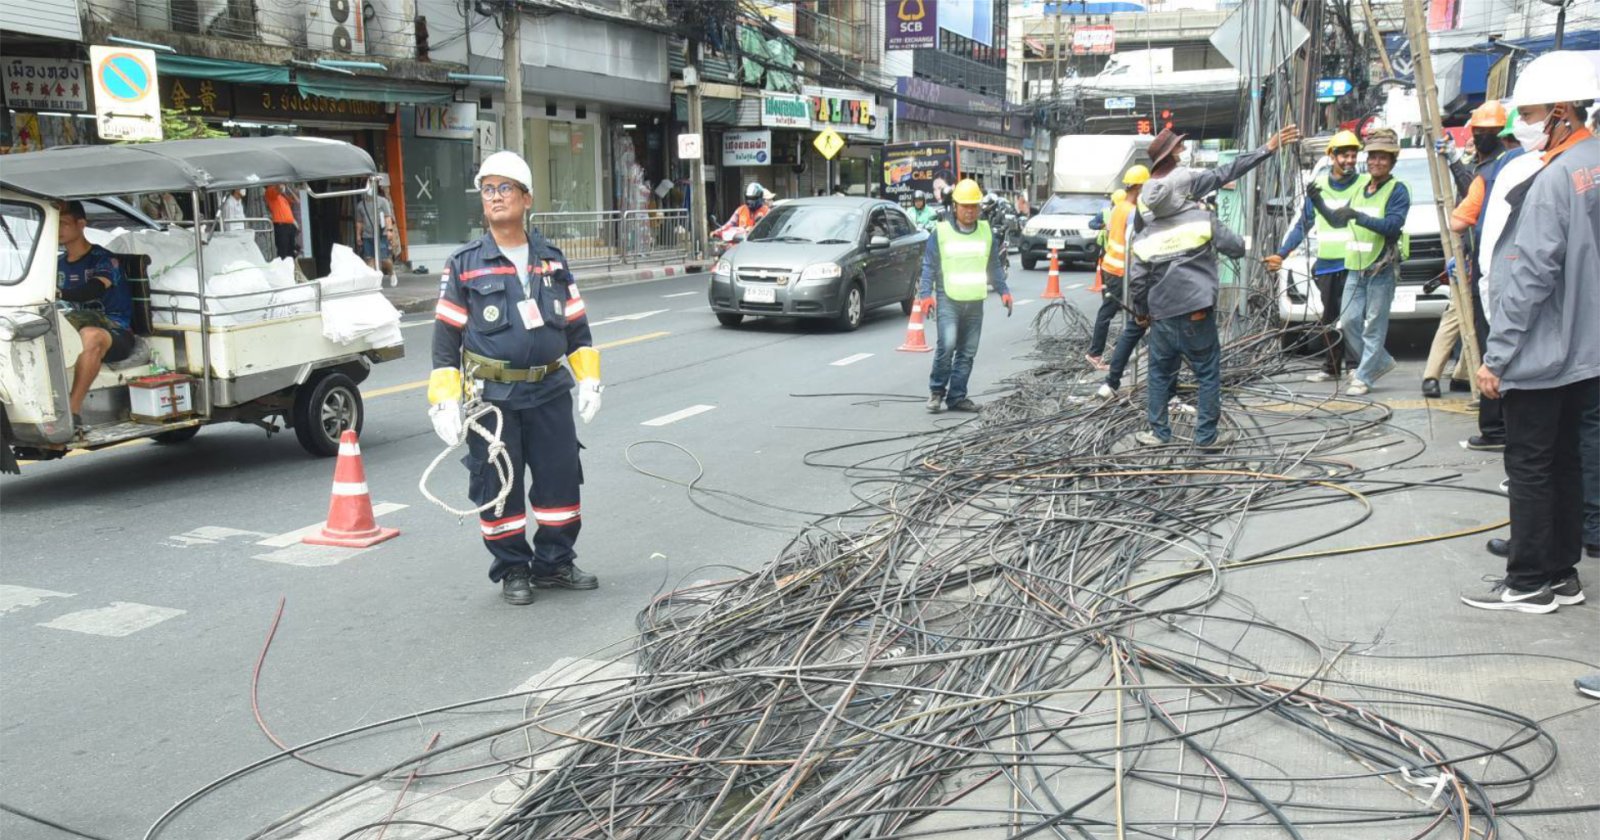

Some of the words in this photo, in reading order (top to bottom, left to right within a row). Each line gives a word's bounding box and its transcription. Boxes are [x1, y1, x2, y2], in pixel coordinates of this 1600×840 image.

[900, 21, 922, 32] SCB
[66, 101, 84, 109] STORE
[809, 96, 869, 125] PALATE
[1136, 120, 1150, 133] 36
[912, 170, 933, 180] C&E
